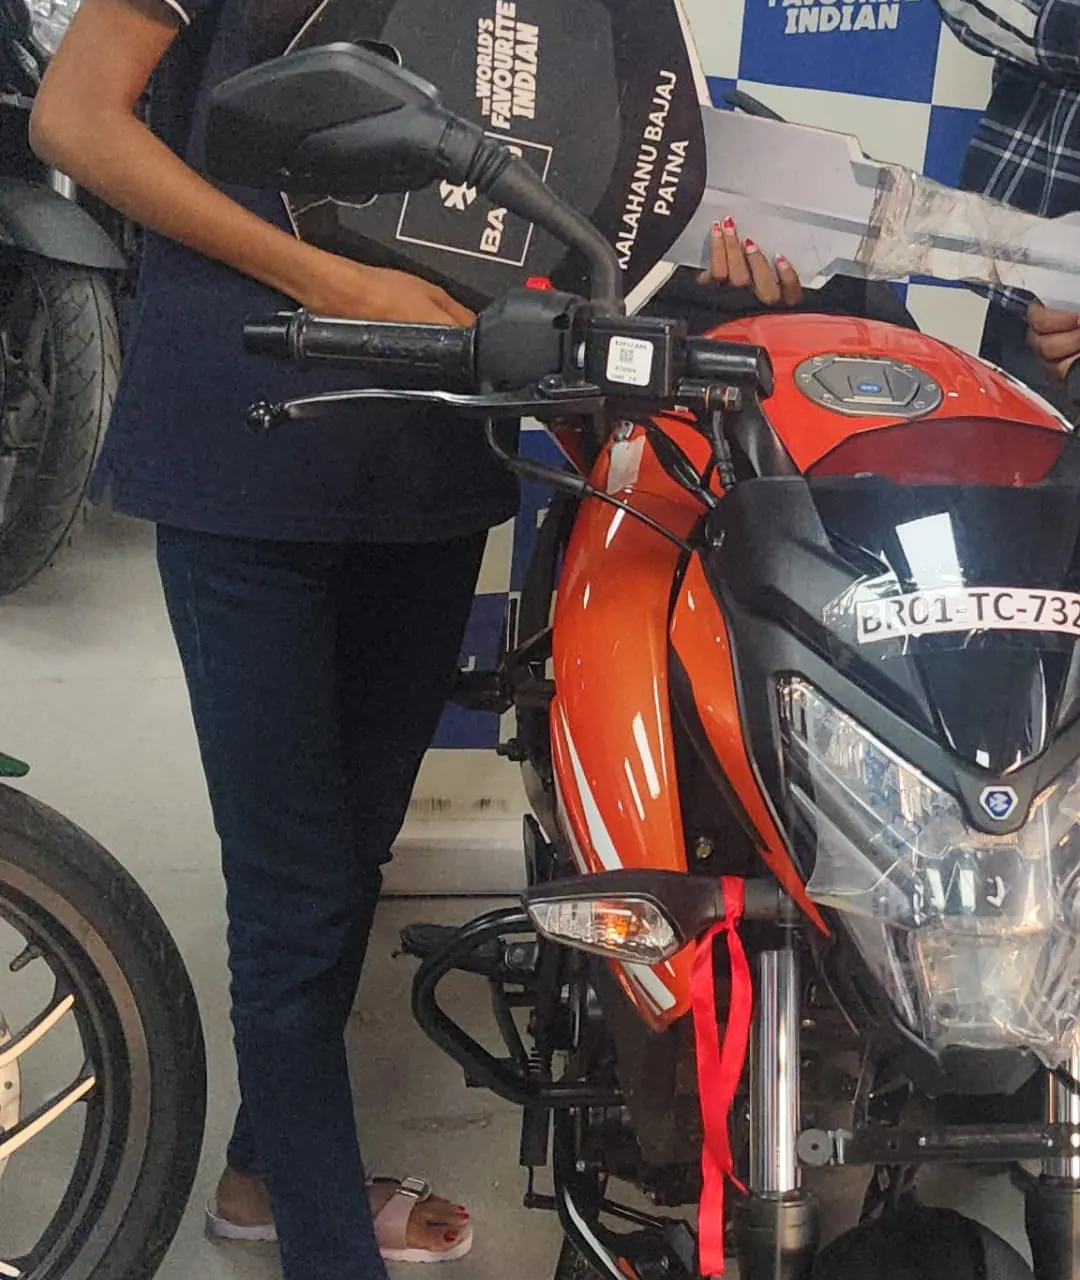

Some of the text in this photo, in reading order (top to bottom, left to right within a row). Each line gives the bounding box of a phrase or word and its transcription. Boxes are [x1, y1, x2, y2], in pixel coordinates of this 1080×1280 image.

[475, 17, 494, 98] WORLD'S
[784, 3, 899, 35] INDIAN
[491, 0, 517, 131] FAVOURITE
[511, 21, 540, 120] INDIAN
[642, 69, 678, 143] BAJAJ
[653, 140, 690, 217] PATNA
